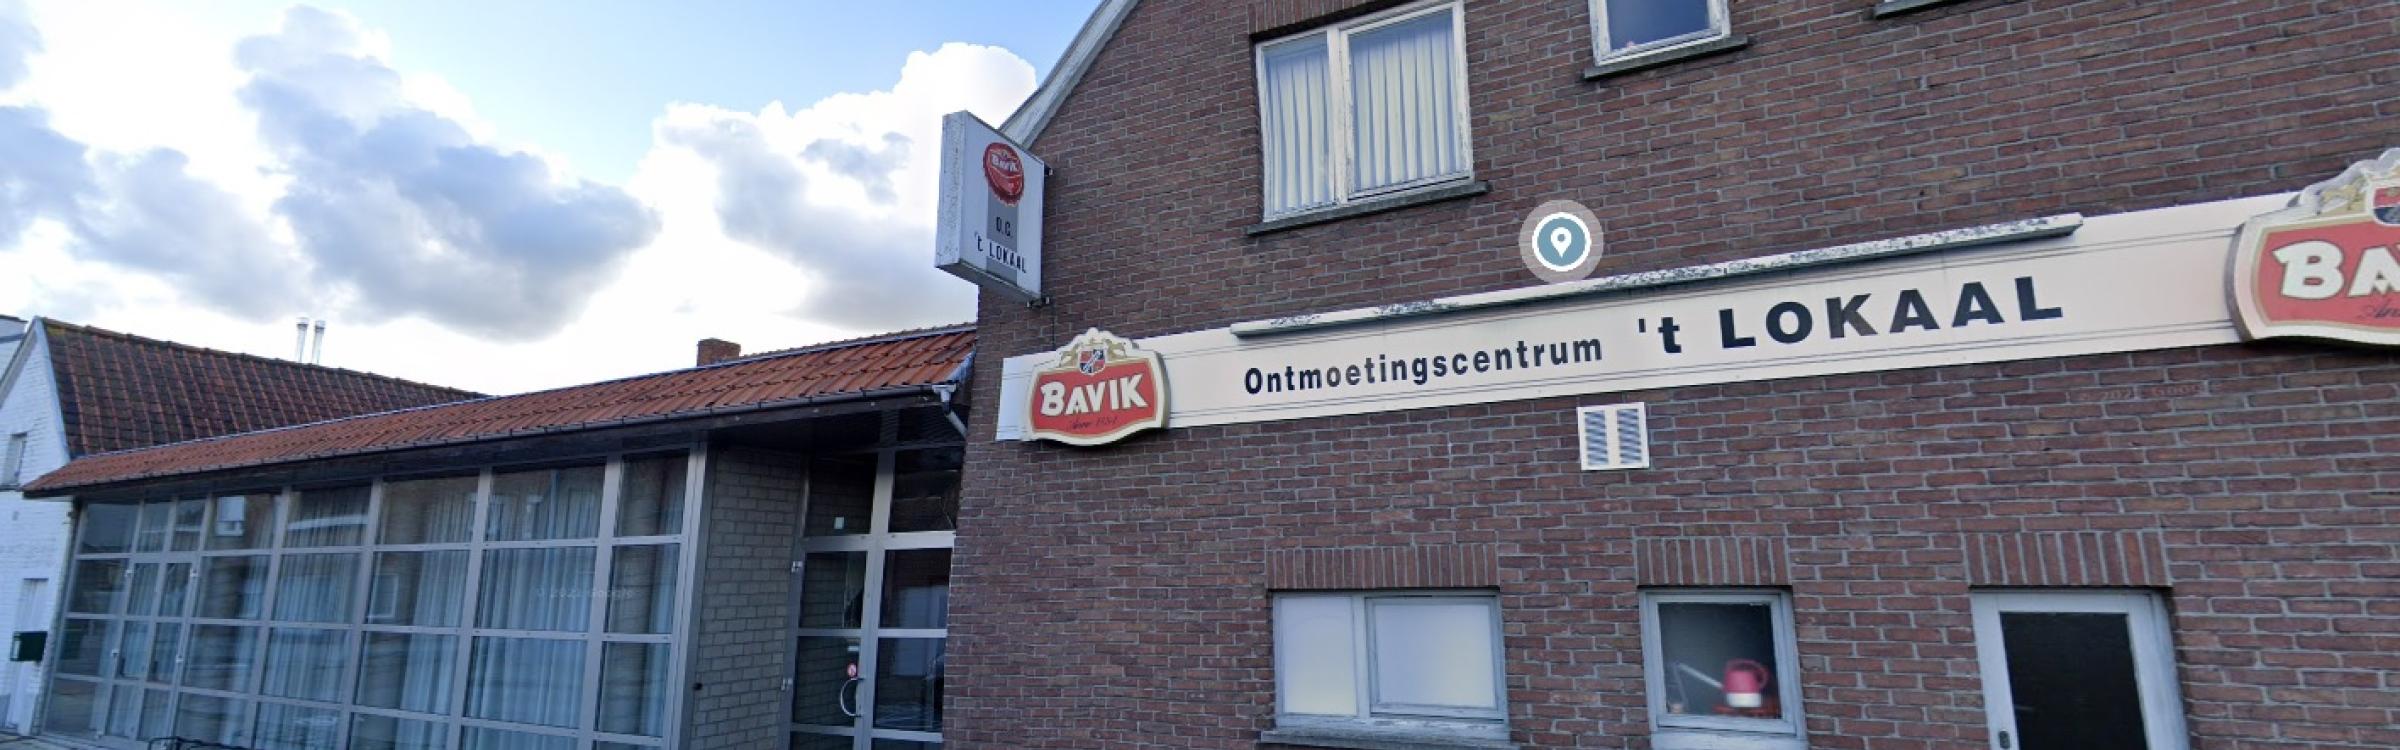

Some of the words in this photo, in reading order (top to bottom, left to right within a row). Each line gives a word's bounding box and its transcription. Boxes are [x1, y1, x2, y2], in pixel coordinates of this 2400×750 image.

[989, 241, 1027, 274] LOKAAL
[1245, 337, 1603, 395] Ontmoetingscentrum
[1638, 315, 1682, 354] 't
[1718, 275, 2064, 349] LOKAAL
[1040, 374, 1148, 417] BAVIK
